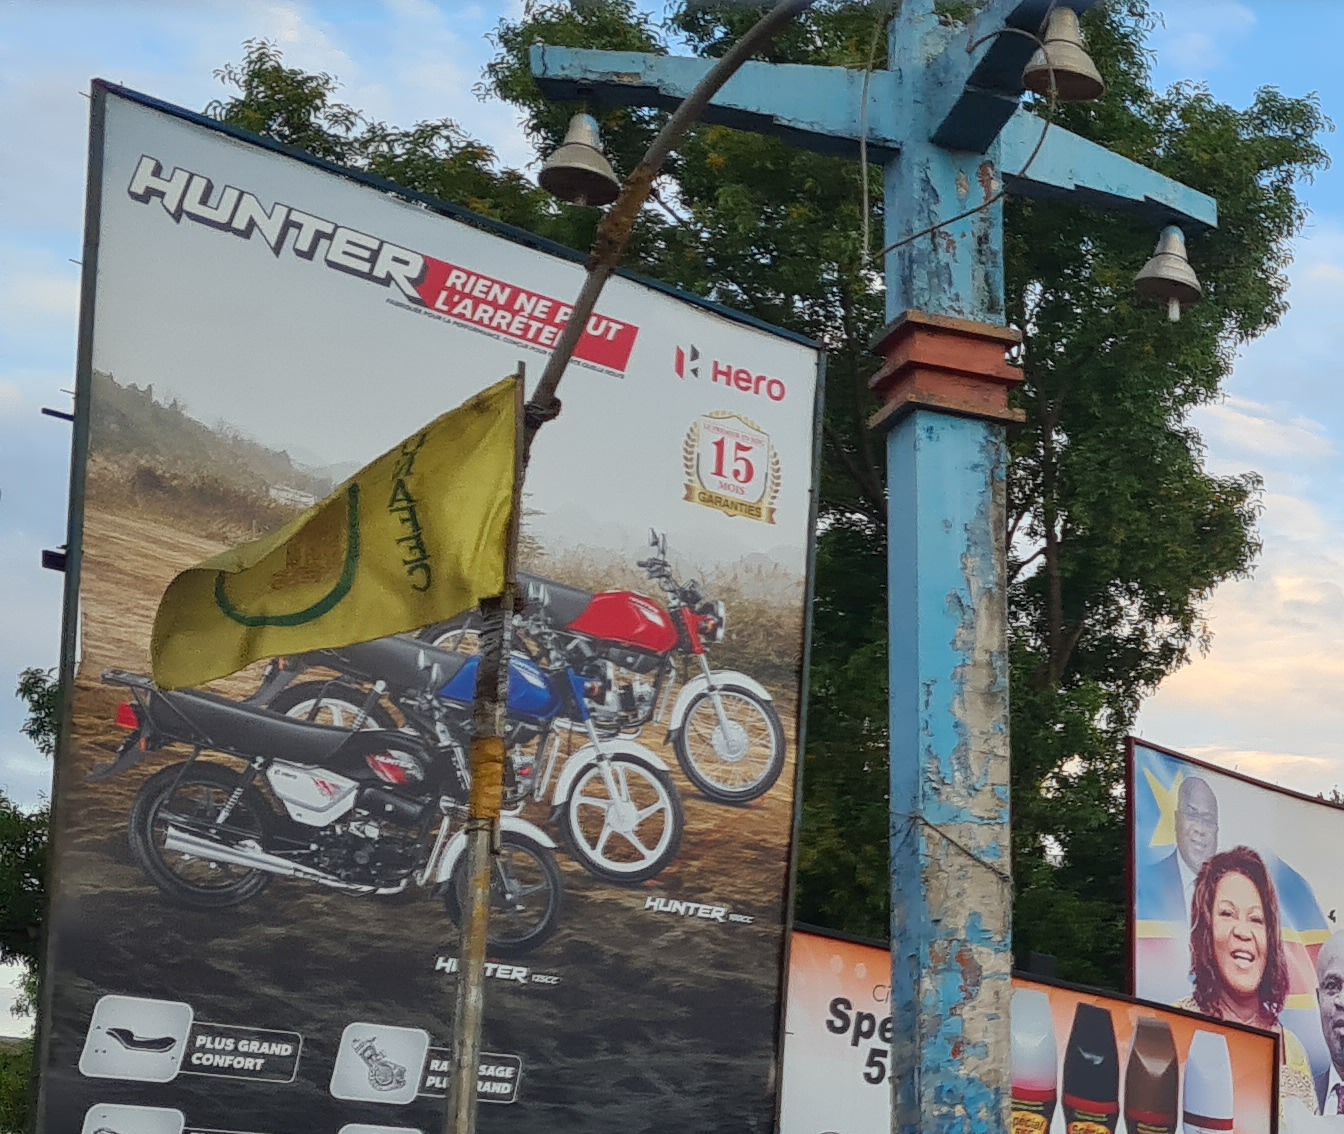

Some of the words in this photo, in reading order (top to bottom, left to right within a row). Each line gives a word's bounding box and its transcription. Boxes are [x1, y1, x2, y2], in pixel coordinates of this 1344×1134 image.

[128, 154, 428, 307] HUNTER
[445, 268, 511, 306] RIEN
[514, 292, 552, 319] NE
[554, 305, 624, 341] PUT
[435, 291, 563, 348] L'ARRÊTE
[710, 436, 755, 485] 15
[718, 480, 747, 497] MOIS
[697, 491, 763, 519] GARANTIES
[645, 896, 727, 923] HUNTER
[195, 1035, 236, 1050] PLUS
[238, 1039, 293, 1057] GRAND
[191, 1052, 266, 1071] CONFORT
